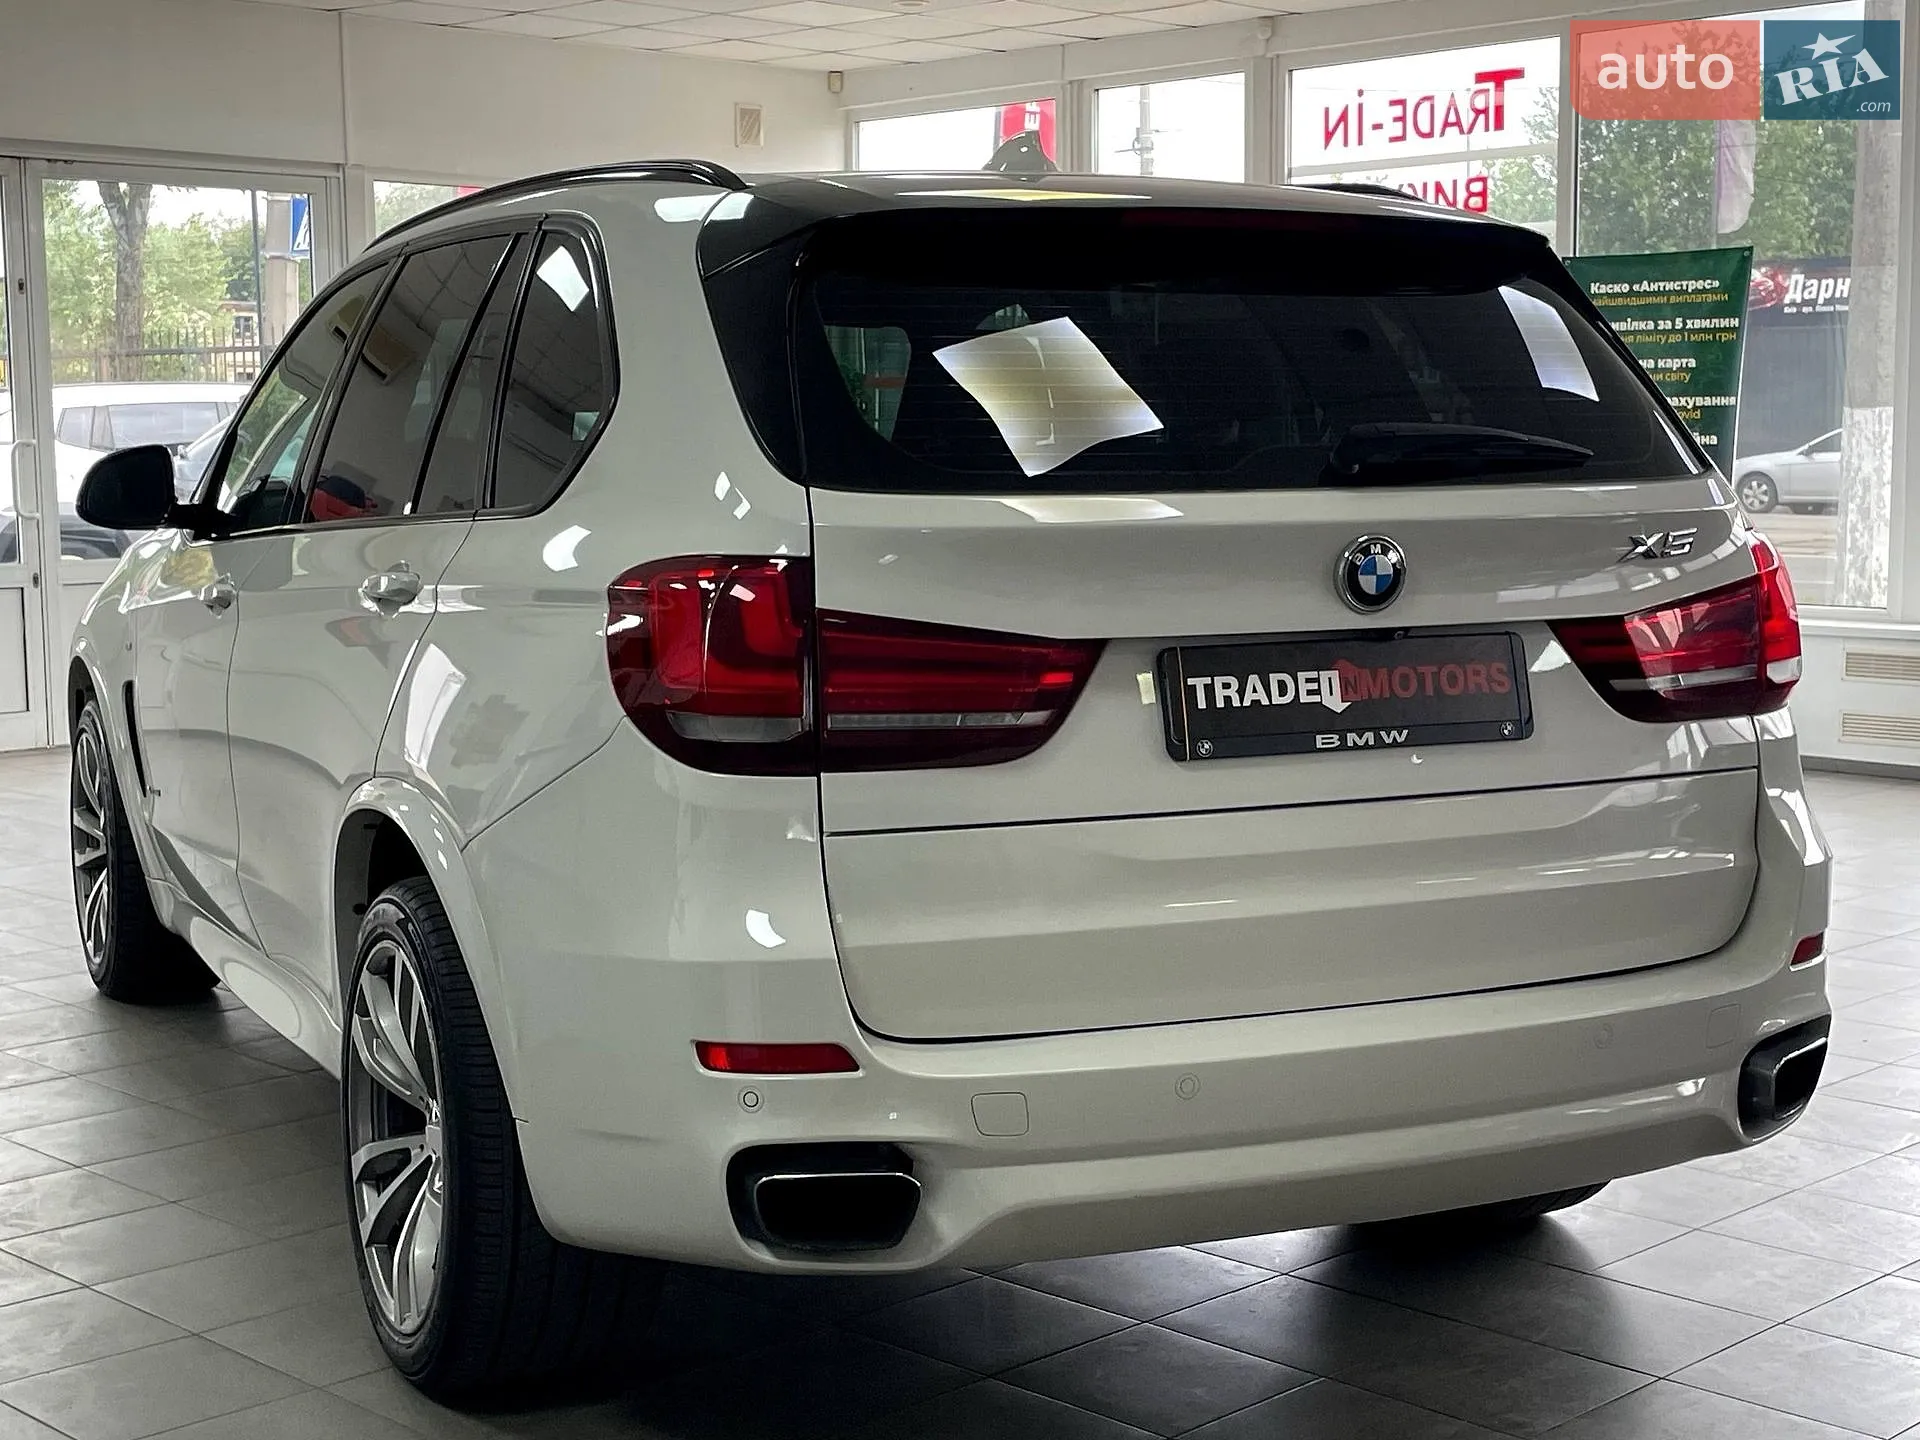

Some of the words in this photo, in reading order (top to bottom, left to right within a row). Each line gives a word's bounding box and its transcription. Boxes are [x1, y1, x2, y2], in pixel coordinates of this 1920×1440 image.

[1590, 282, 1630, 294] Каско
[1632, 279, 1720, 293] «Антистрес»
[1784, 273, 1851, 304] Дарн
[1669, 293, 1728, 304] виплатами
[1657, 319, 1673, 330] за
[1674, 317, 1683, 330] 5
[1685, 317, 1739, 330] хвилин
[1668, 333, 1682, 344] до
[1684, 332, 1688, 341] 1
[1690, 332, 1713, 341] млн
[1716, 332, 1737, 344] грн
[1657, 357, 1697, 371] карта
[1665, 371, 1692, 383] світу
[1619, 527, 1698, 562] X5
[1315, 729, 1409, 749] BMW
